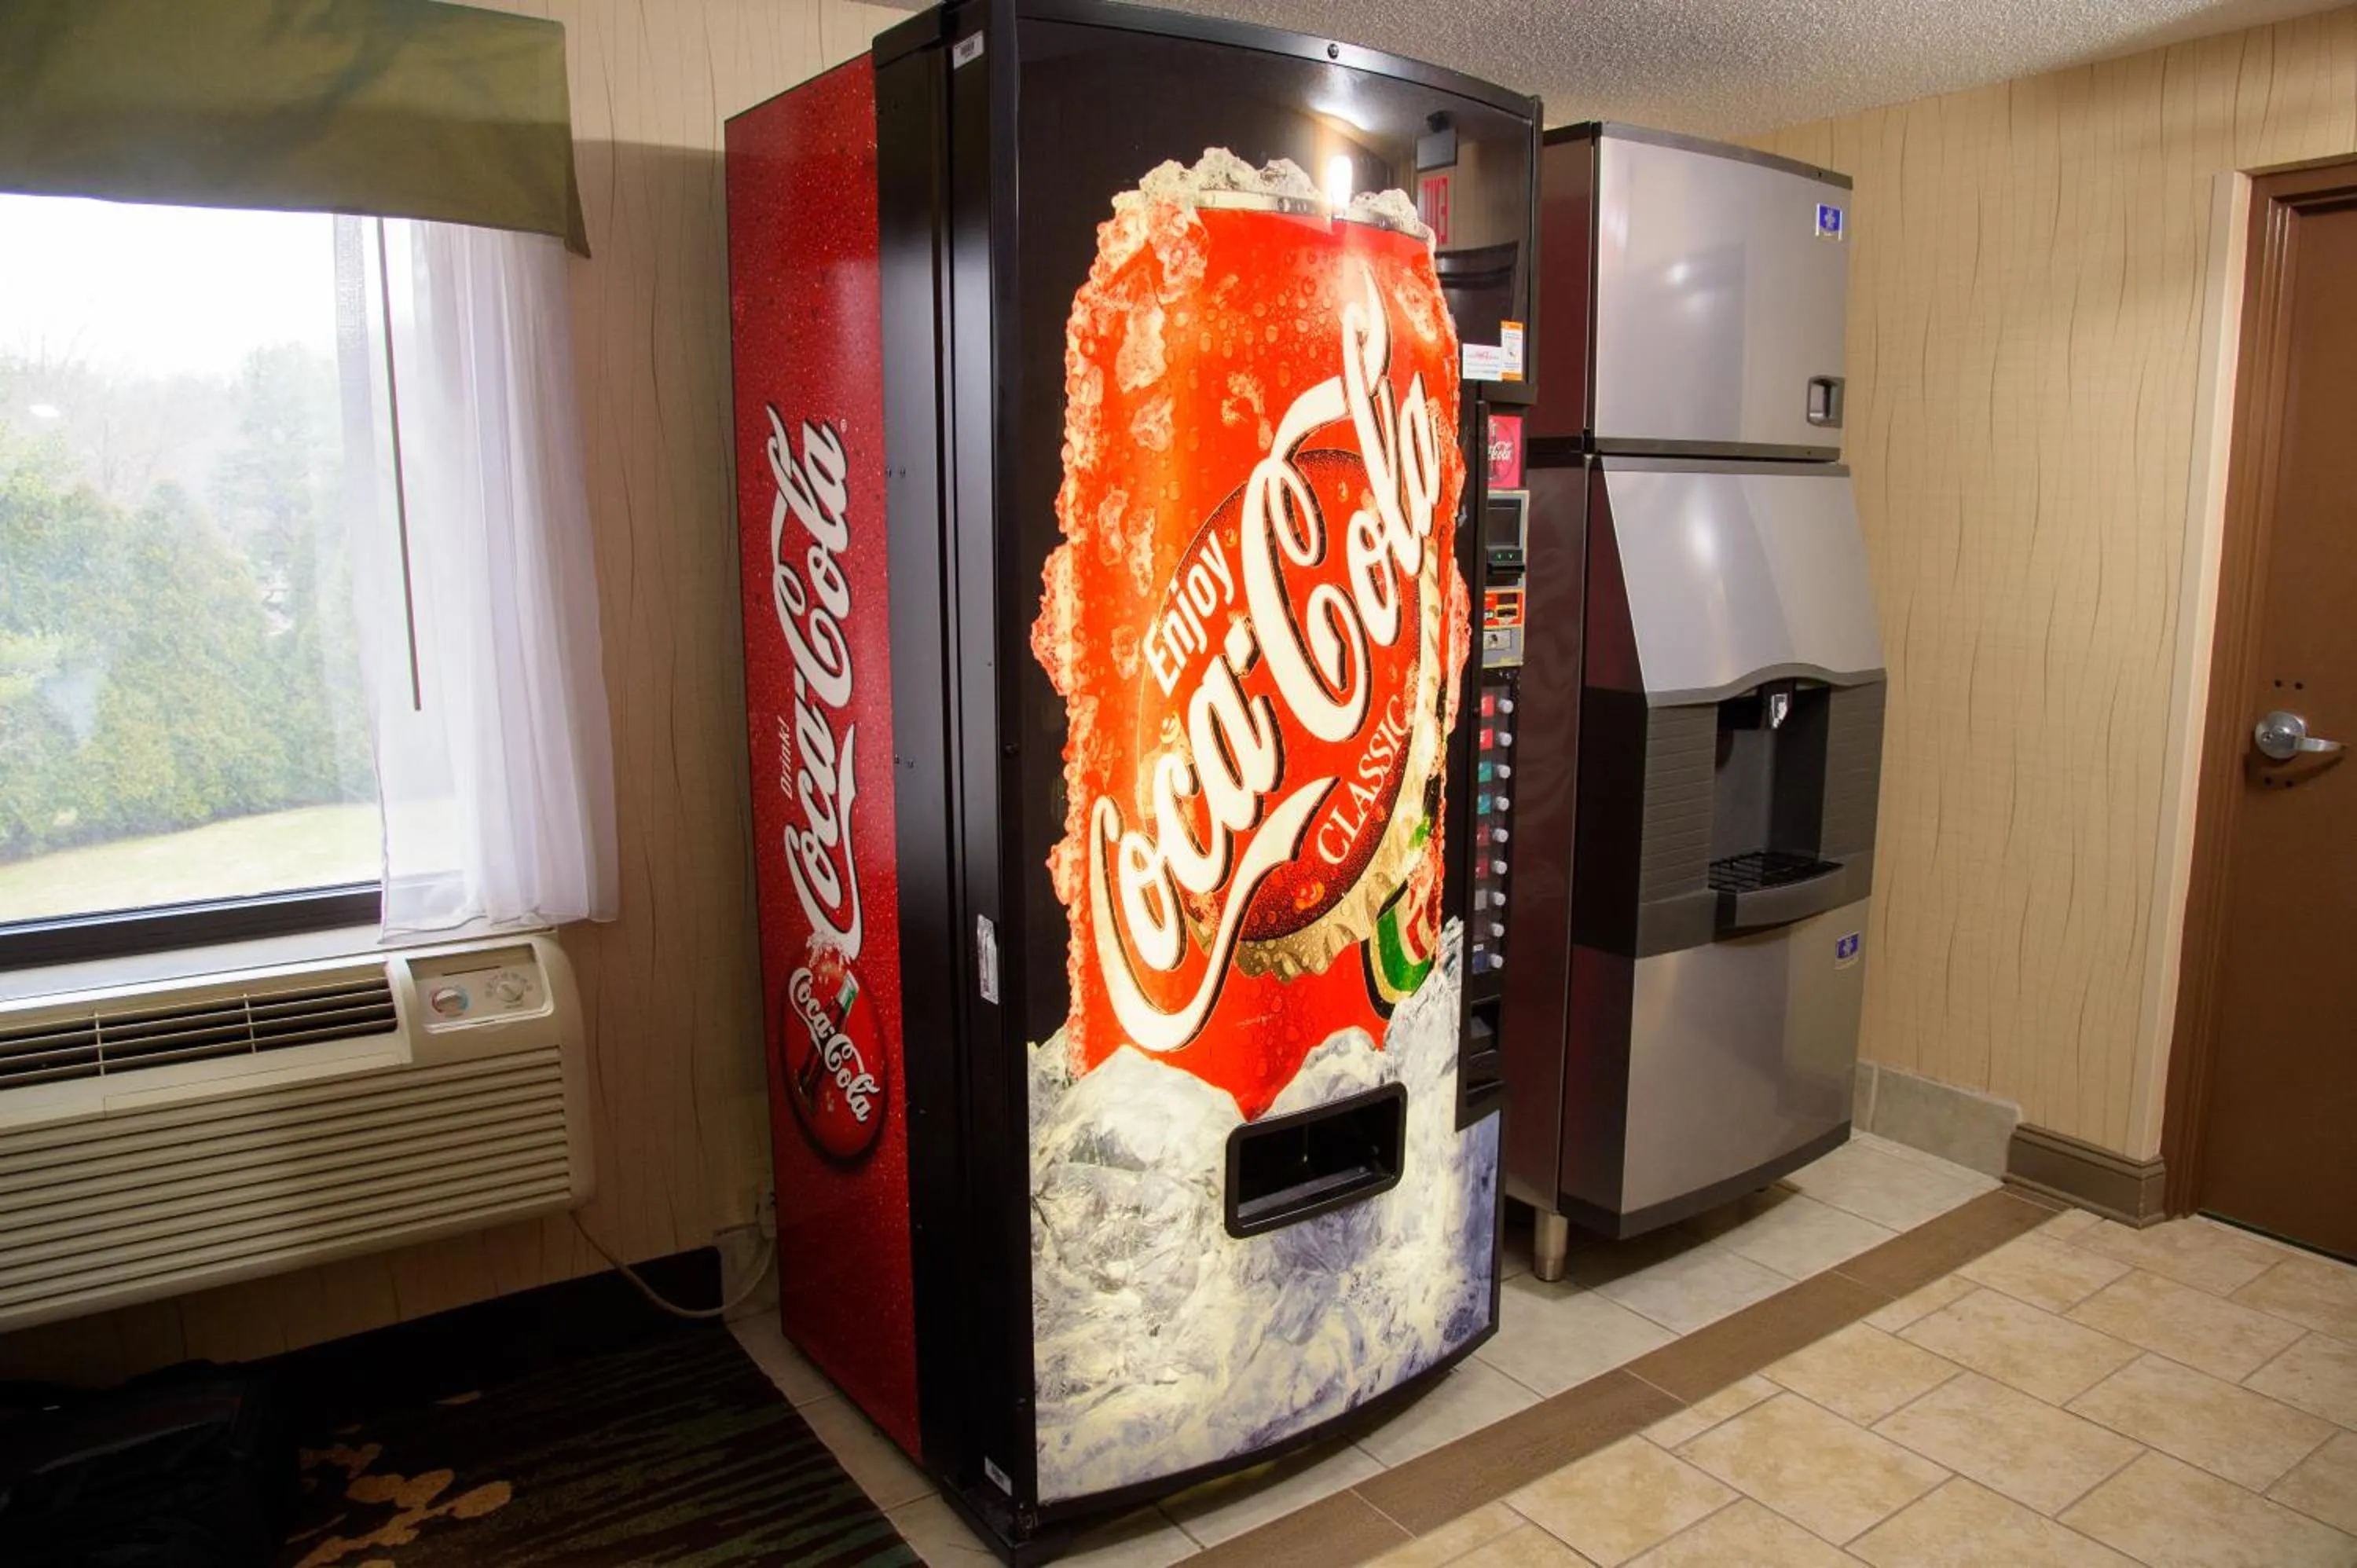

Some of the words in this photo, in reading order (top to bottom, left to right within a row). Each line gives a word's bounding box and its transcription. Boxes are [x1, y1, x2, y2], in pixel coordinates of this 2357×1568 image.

[766, 402, 862, 960] Coca-Cola
[1090, 265, 1439, 1052] Coca-Cola
[1142, 529, 1235, 698] Enjoy
[1318, 694, 1410, 864] CLASSIC
[788, 967, 881, 1122] Coca-Cola
